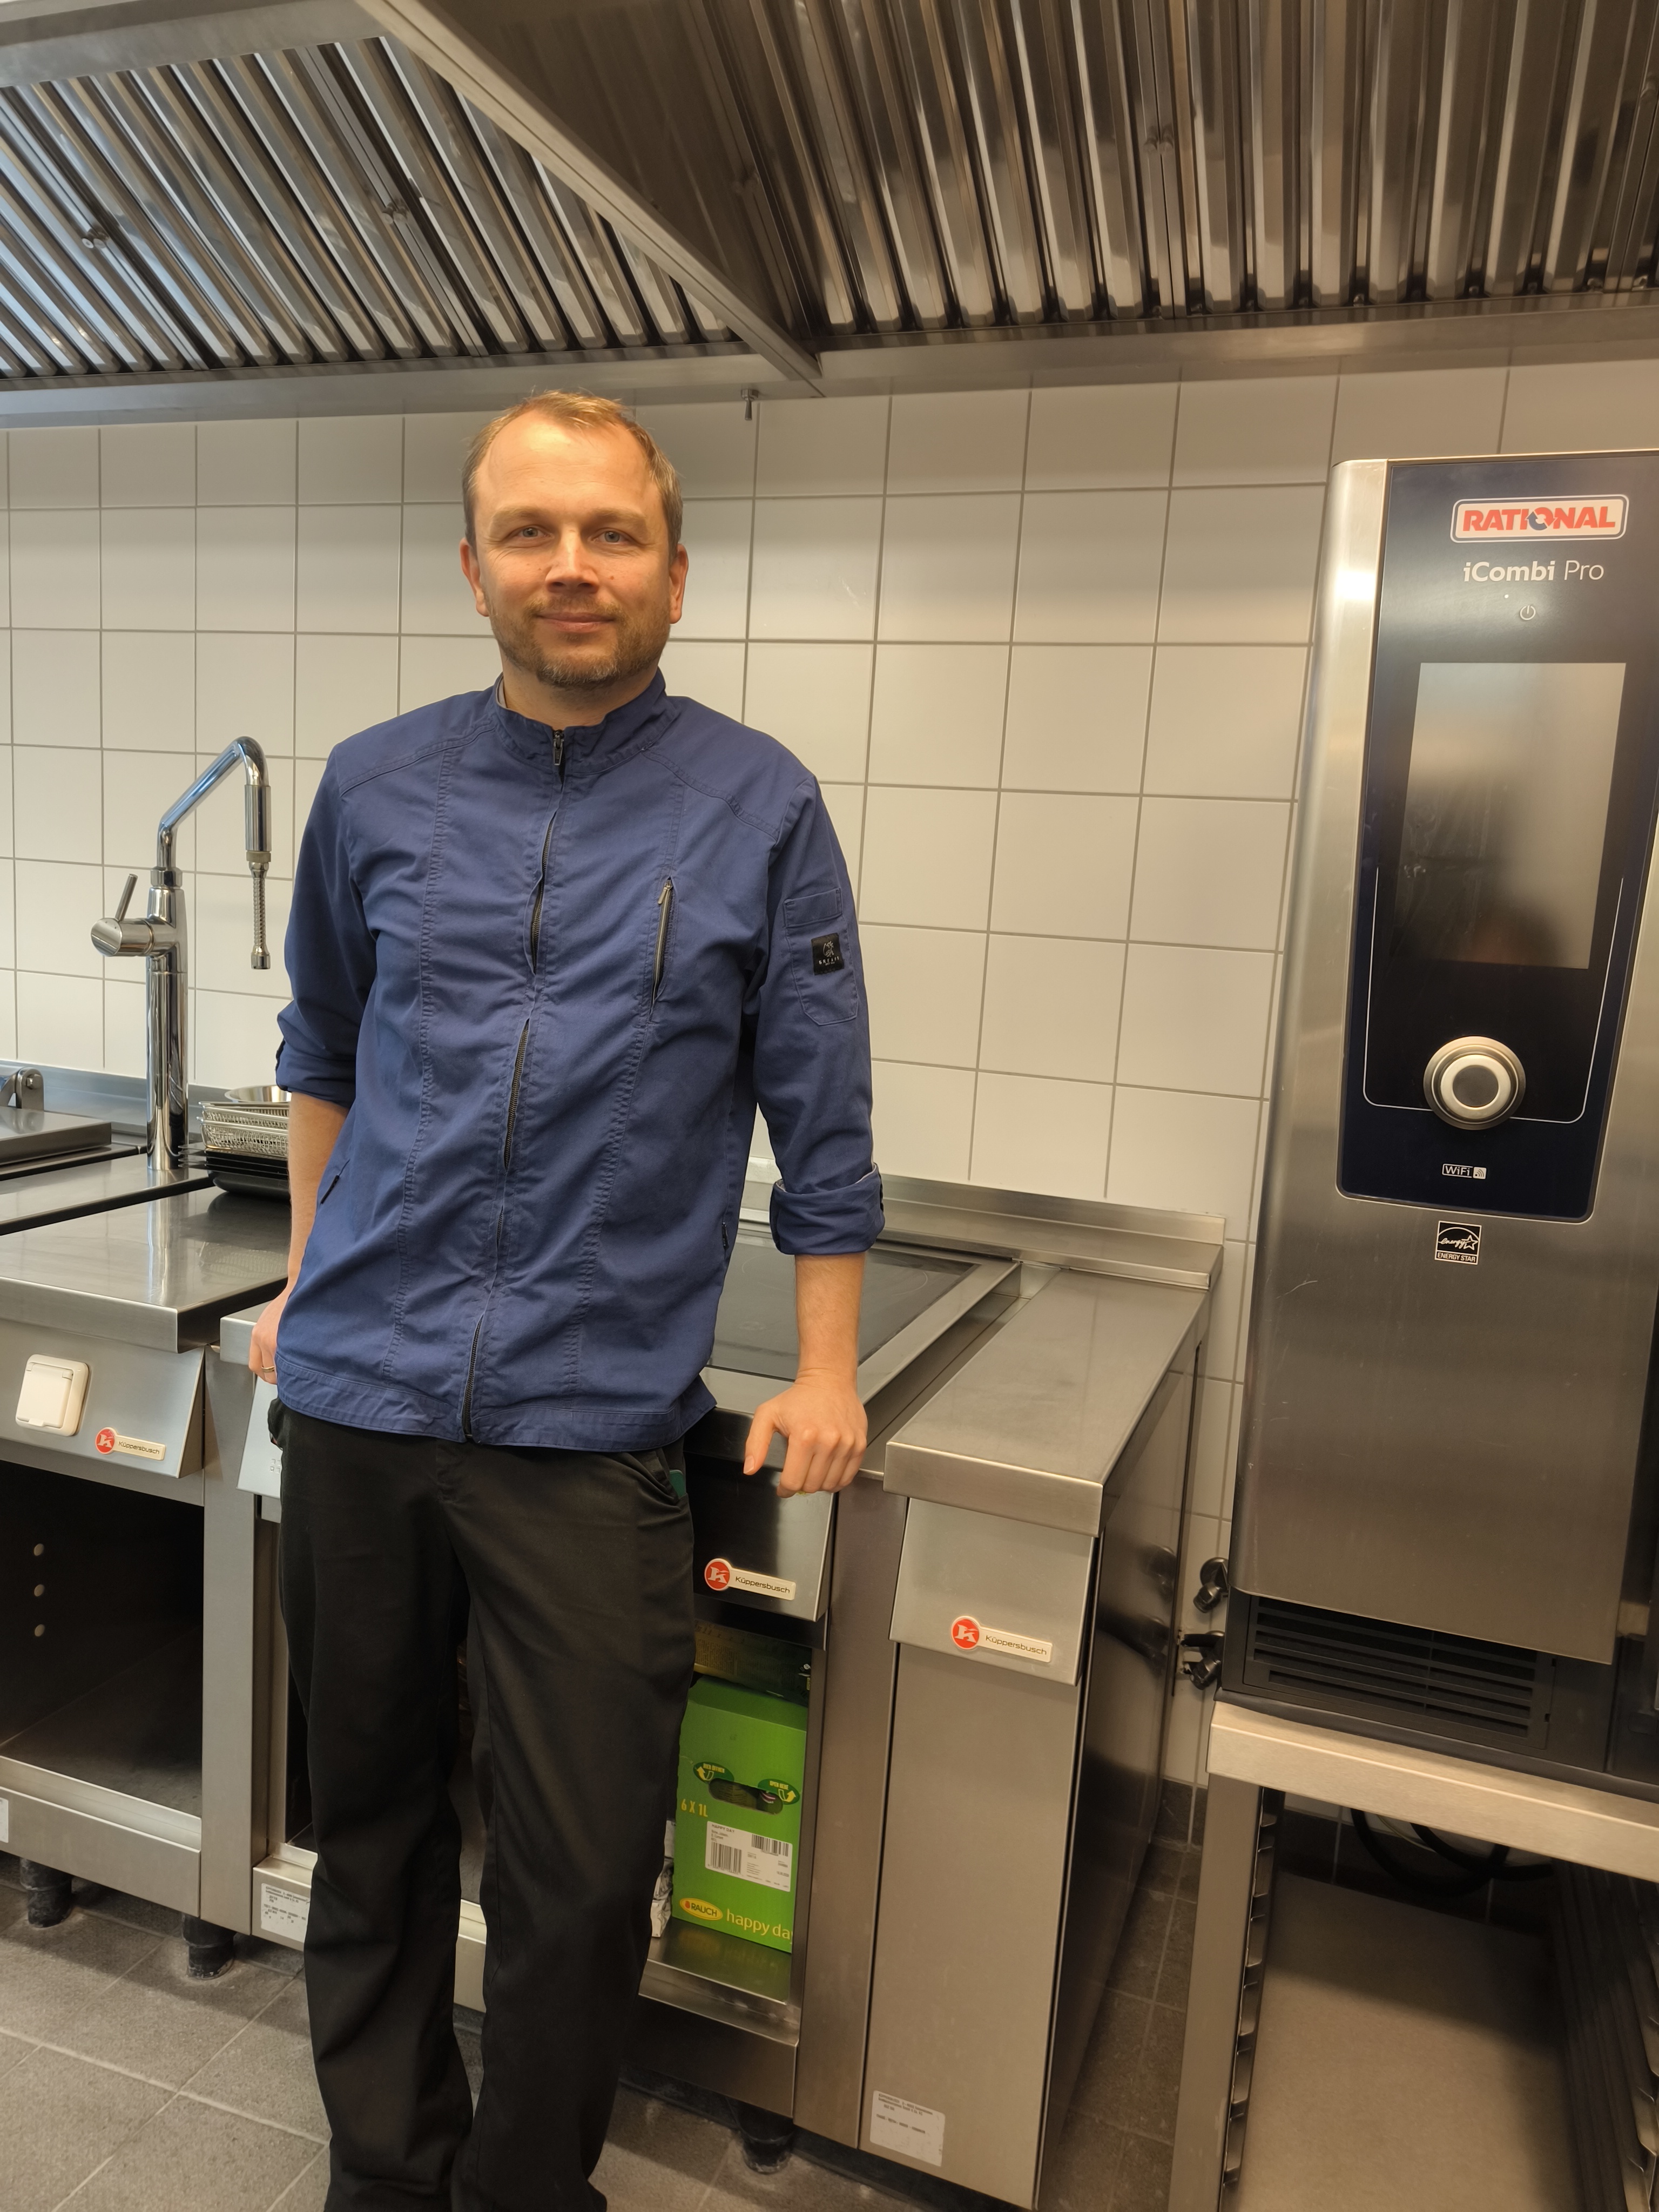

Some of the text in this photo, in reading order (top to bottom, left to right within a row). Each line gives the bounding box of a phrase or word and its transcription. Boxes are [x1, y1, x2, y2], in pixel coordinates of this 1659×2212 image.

[1462, 506, 1616, 531] RATIONAL
[1463, 559, 1604, 582] iCombi Pro
[1445, 1165, 1470, 1176] WiFi
[1437, 1252, 1476, 1263] ENERGY STAR
[118, 1441, 160, 1454] Küppersbusch
[735, 1576, 790, 1594] Küppersbusch
[986, 1635, 1047, 1655] Küppersbusch
[681, 1798, 687, 1811] 6
[698, 1803, 708, 1817] 1L
[691, 1903, 717, 1917] RAUCH
[727, 1908, 793, 1944] happy da
